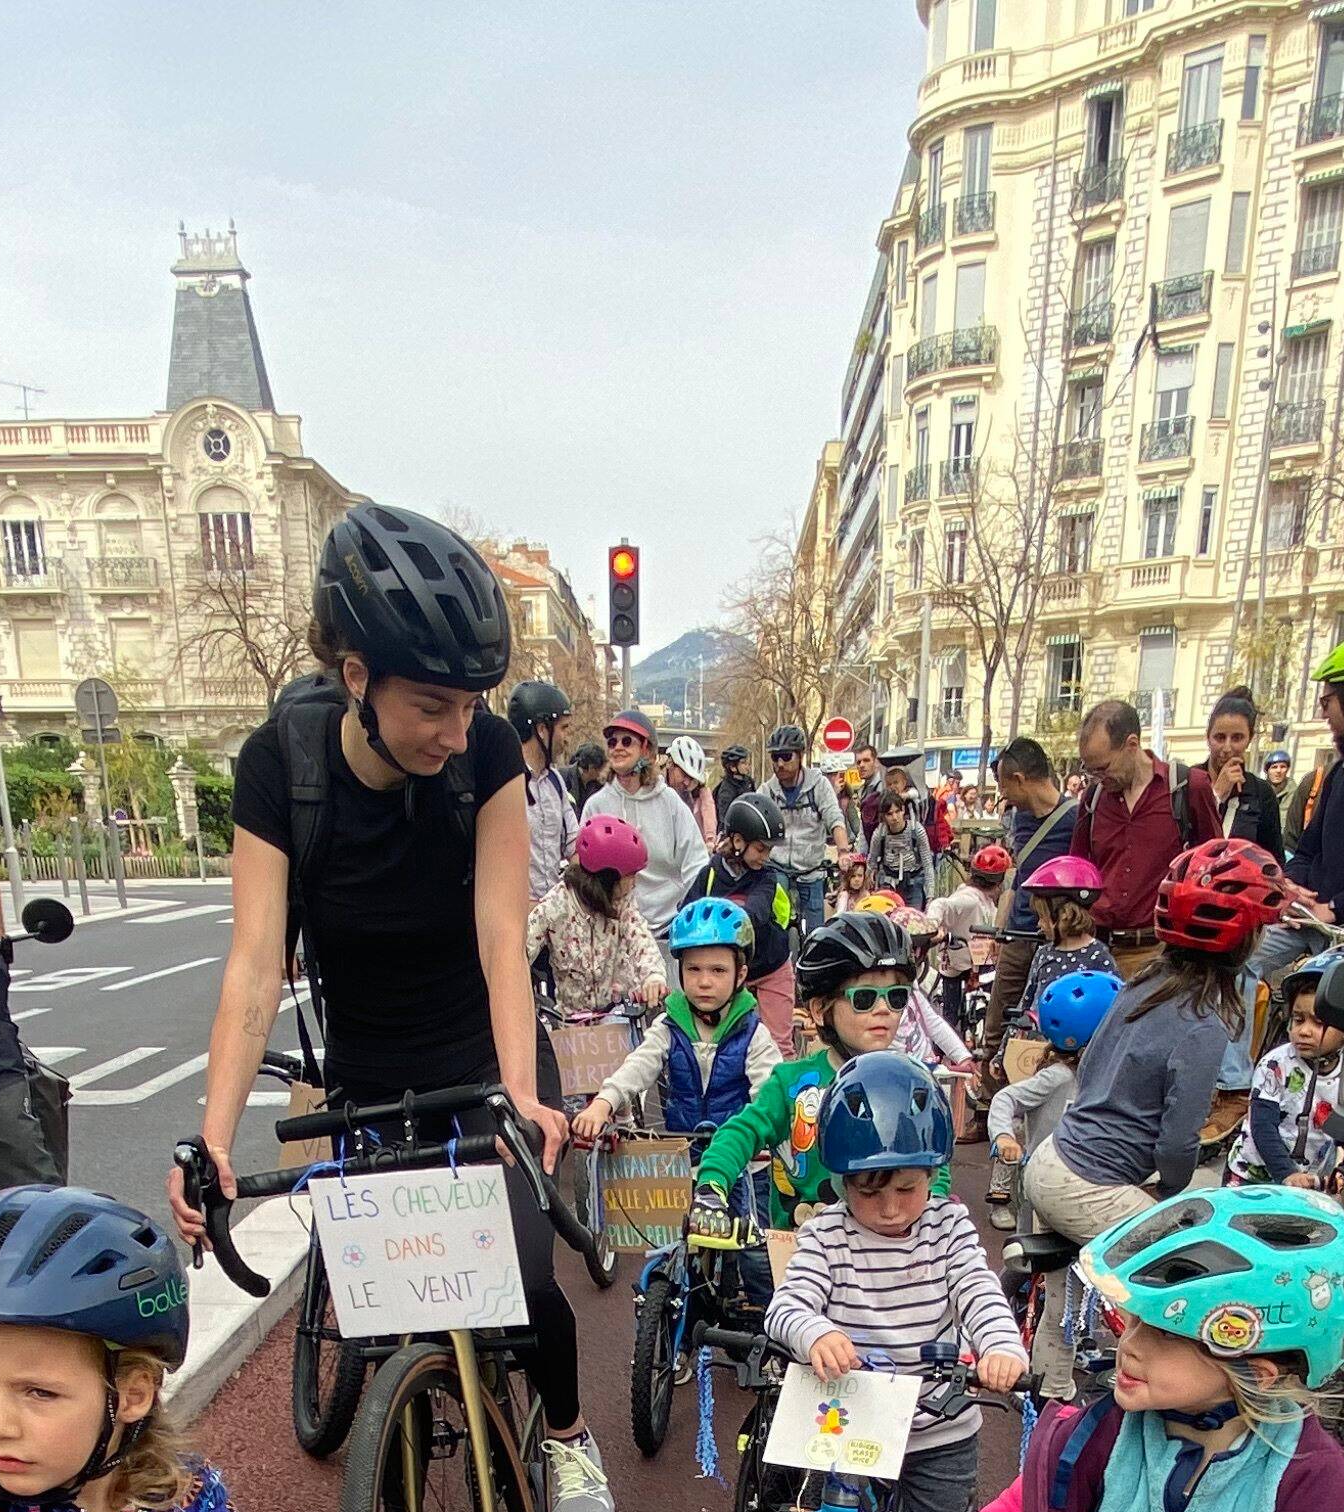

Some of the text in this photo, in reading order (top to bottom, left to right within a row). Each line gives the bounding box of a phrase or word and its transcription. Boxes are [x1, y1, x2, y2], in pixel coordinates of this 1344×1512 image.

[556, 1031, 632, 1057] ANTS EN
[326, 1179, 501, 1221] LES CHEVEUX
[647, 1188, 688, 1210] VILLES
[384, 1232, 447, 1261] DANS
[606, 1223, 643, 1247] PLUS
[347, 1270, 479, 1309] LE VENT
